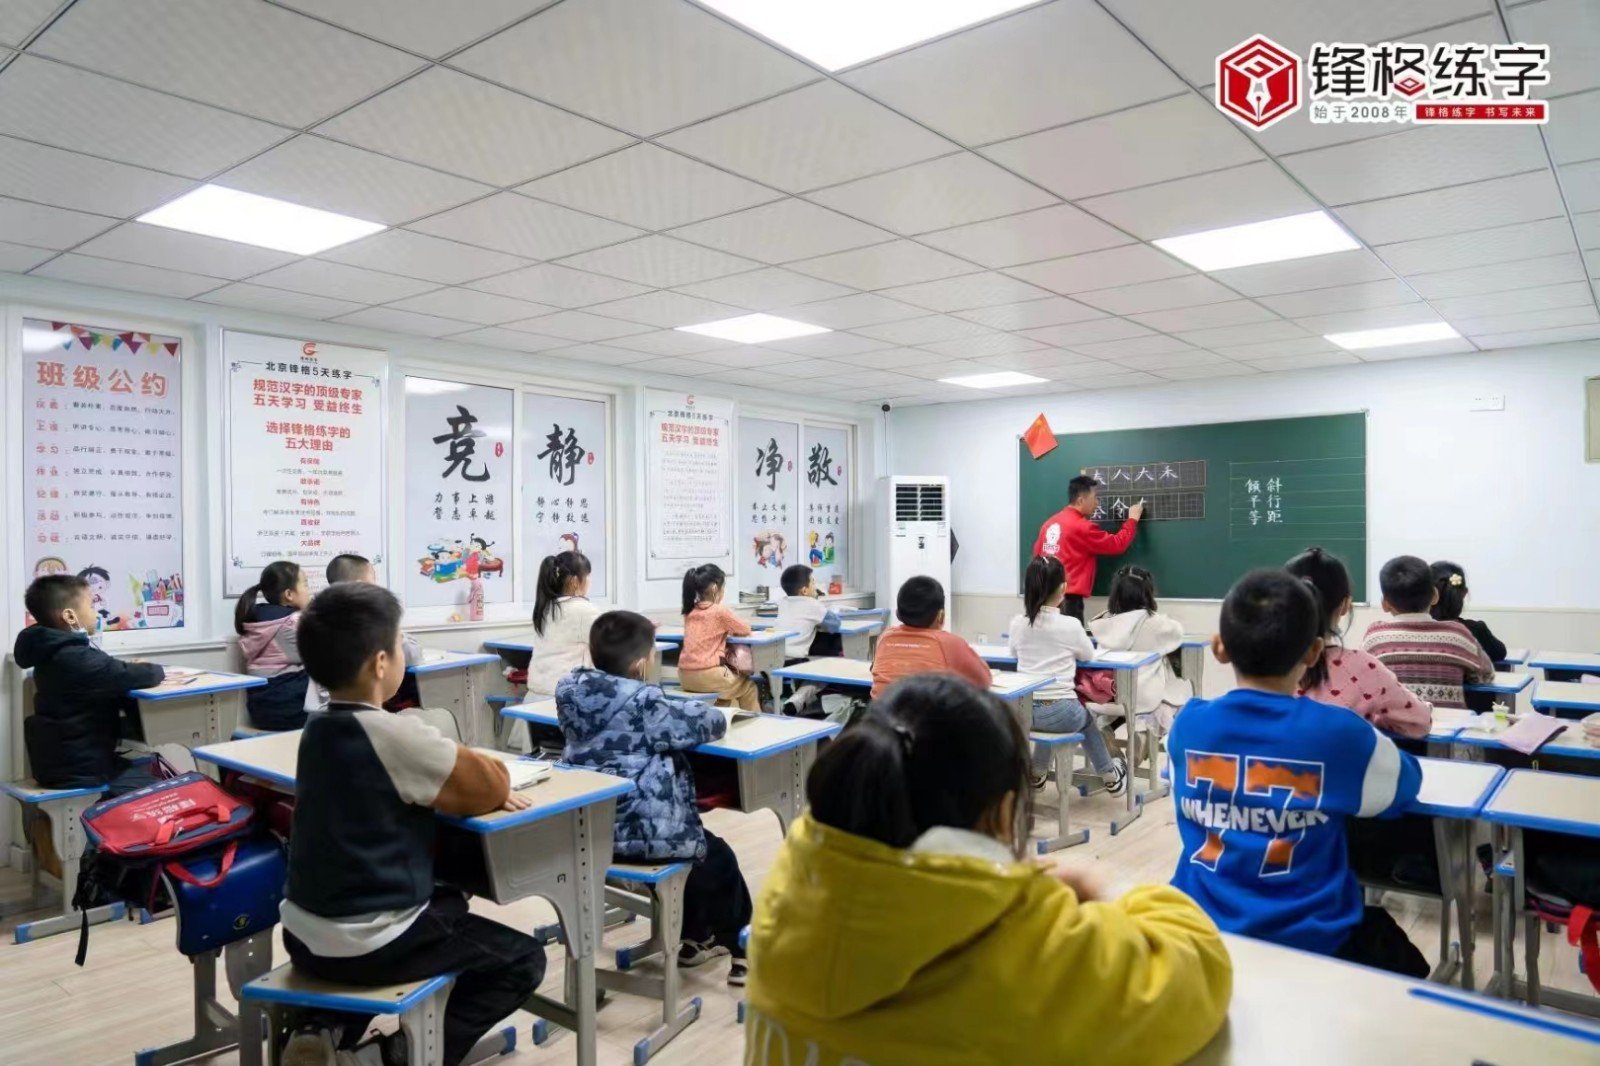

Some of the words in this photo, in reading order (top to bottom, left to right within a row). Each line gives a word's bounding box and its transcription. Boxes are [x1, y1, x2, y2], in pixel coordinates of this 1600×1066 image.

[36, 361, 167, 398] 班级公约
[253, 379, 363, 400] 规范汉字的顶级专家
[254, 394, 306, 410] 五天学习
[313, 400, 363, 415] 受益终生
[266, 421, 351, 439] 选择锋格练字的
[285, 437, 334, 451] 五大理由
[432, 404, 491, 482] 竞
[537, 423, 586, 486] 静
[755, 437, 784, 492] 净
[535, 511, 590, 523] 宁静致远
[1181, 796, 1329, 833] WHENEVER
